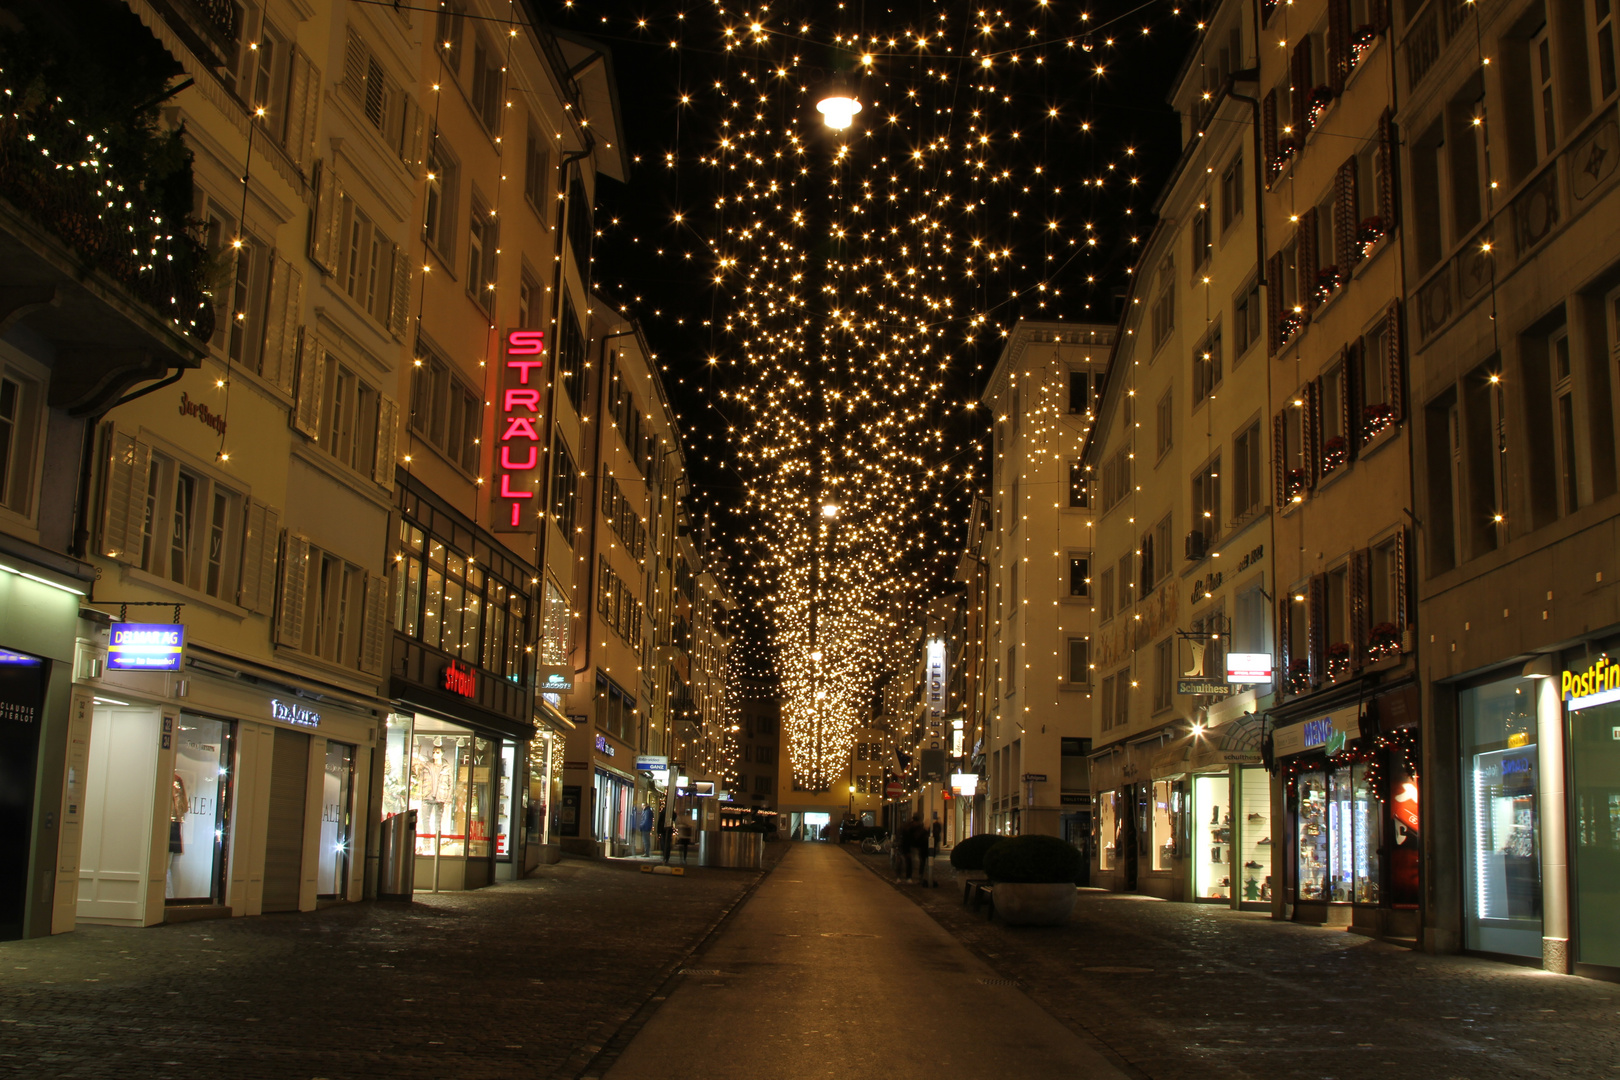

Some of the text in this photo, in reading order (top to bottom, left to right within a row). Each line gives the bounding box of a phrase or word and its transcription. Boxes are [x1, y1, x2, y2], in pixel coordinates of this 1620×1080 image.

[501, 331, 544, 526] STRÄULI
[115, 631, 179, 645] DELMAR AG
[446, 659, 476, 698] sträuli
[1180, 682, 1229, 694] Schulthess
[1562, 658, 1620, 701] PostFin
[0, 702, 34, 715] CLAUDIE
[0, 711, 34, 723] PIERLOT
[1304, 716, 1333, 747] MENG
